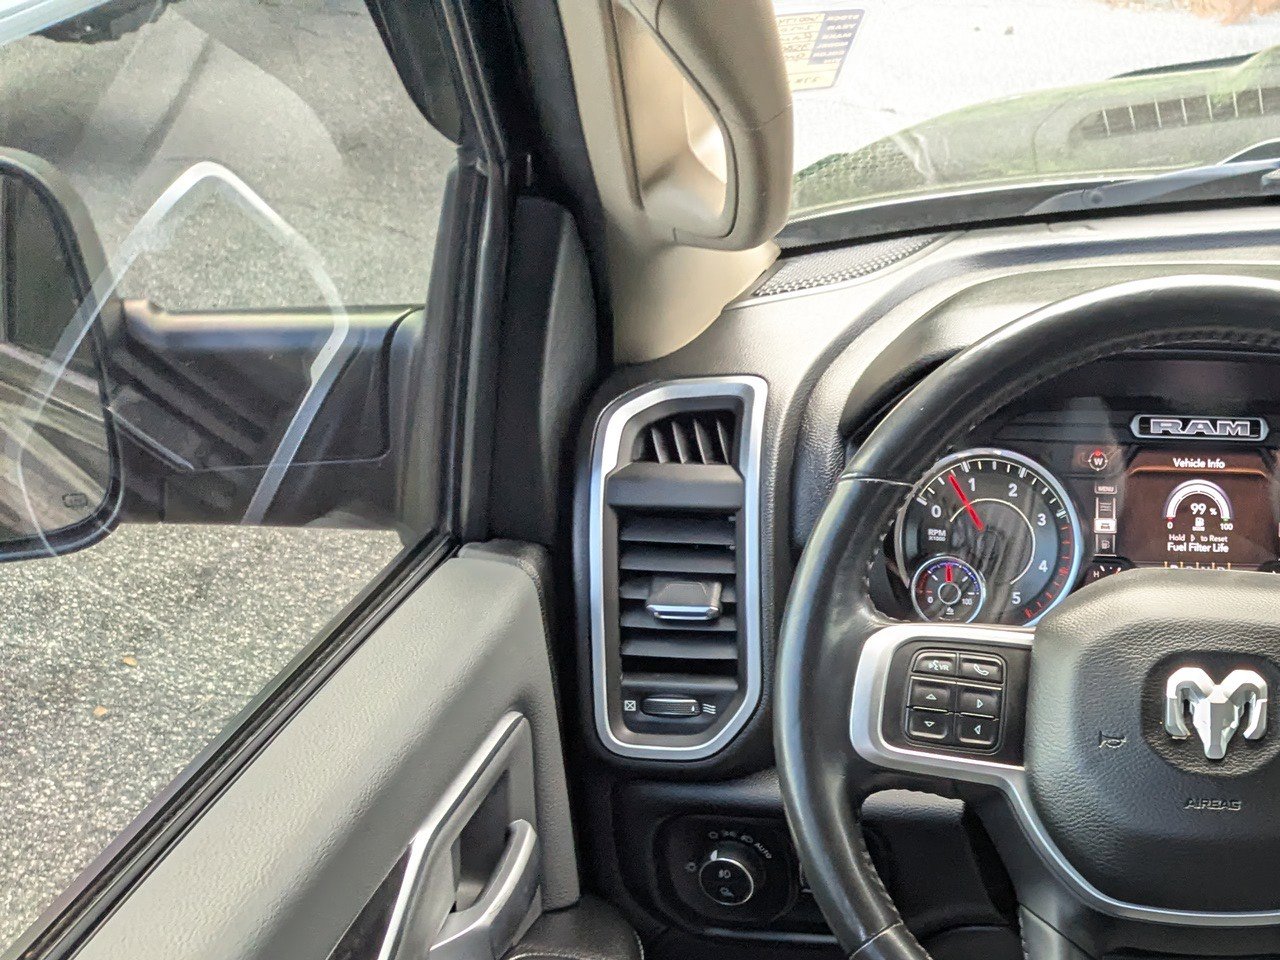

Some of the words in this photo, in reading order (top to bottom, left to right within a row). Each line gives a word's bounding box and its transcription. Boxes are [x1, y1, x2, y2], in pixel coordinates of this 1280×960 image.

[1150, 418, 1250, 436] RAM
[1094, 457, 1103, 466] W
[1173, 457, 1206, 469] Vehicle
[1207, 458, 1226, 469] Info
[968, 478, 976, 491] 1
[1008, 483, 1018, 497] 2
[931, 505, 941, 518] 0
[1190, 503, 1207, 515] 99
[1209, 507, 1218, 516] %
[1037, 513, 1047, 526] 3
[1167, 522, 1173, 530] 0
[928, 528, 946, 537] RPM
[1220, 522, 1234, 531] 100
[1169, 534, 1185, 542] Hold
[1200, 534, 1208, 542] to
[1209, 535, 1228, 543] Reset
[1167, 543, 1187, 553] Fuel
[1188, 543, 1211, 553] Filter
[1212, 543, 1229, 553] Life
[1038, 560, 1048, 573] 4
[962, 598, 973, 606] 100
[1011, 591, 1021, 605] 5
[1184, 798, 1242, 811] AIRBAG
